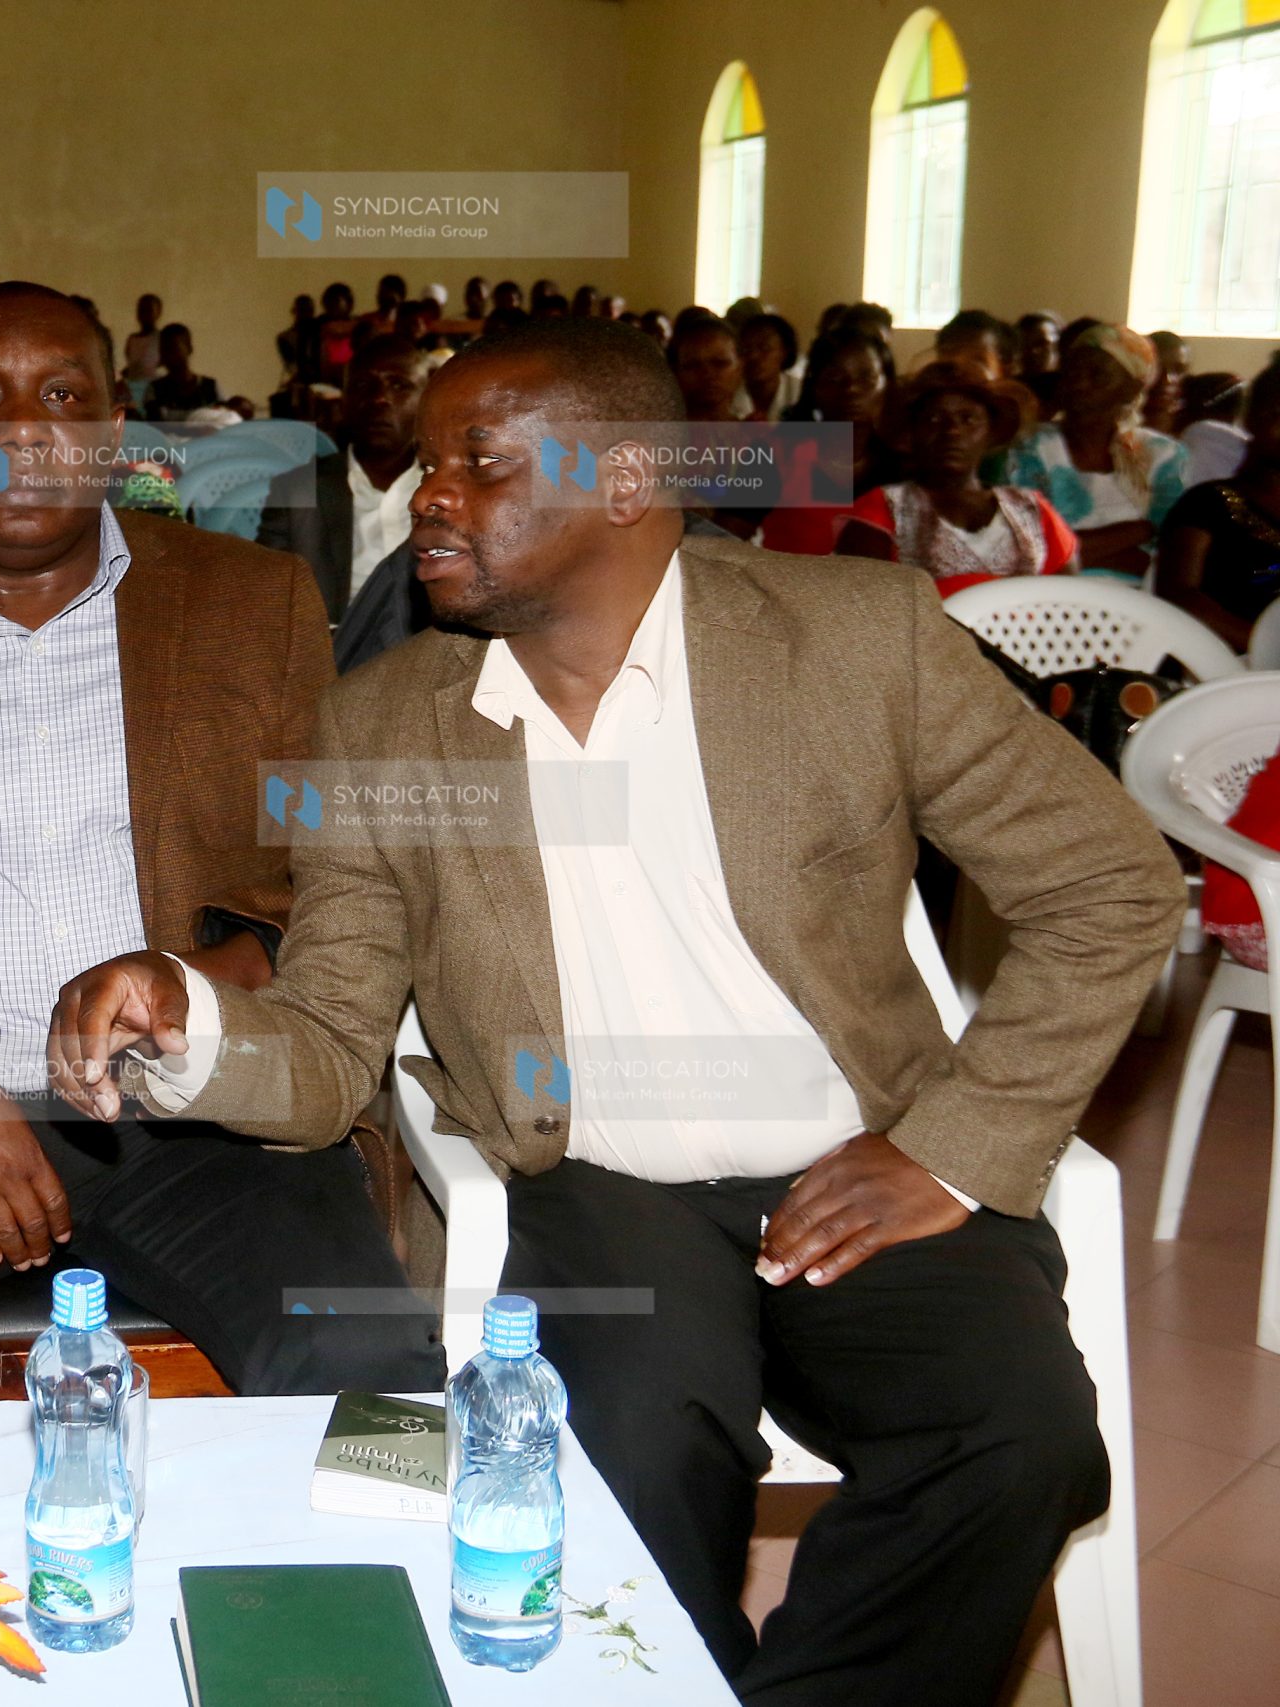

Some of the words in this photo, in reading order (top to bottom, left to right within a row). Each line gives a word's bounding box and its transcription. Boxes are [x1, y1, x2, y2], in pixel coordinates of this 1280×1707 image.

[494, 1328, 509, 1336] COOL
[495, 1318, 509, 1326] COOL
[340, 1443, 399, 1465] Injili
[336, 1454, 446, 1488] Nyimbo
[49, 1548, 94, 1573] RIVERS
[521, 1550, 549, 1573] COOL
